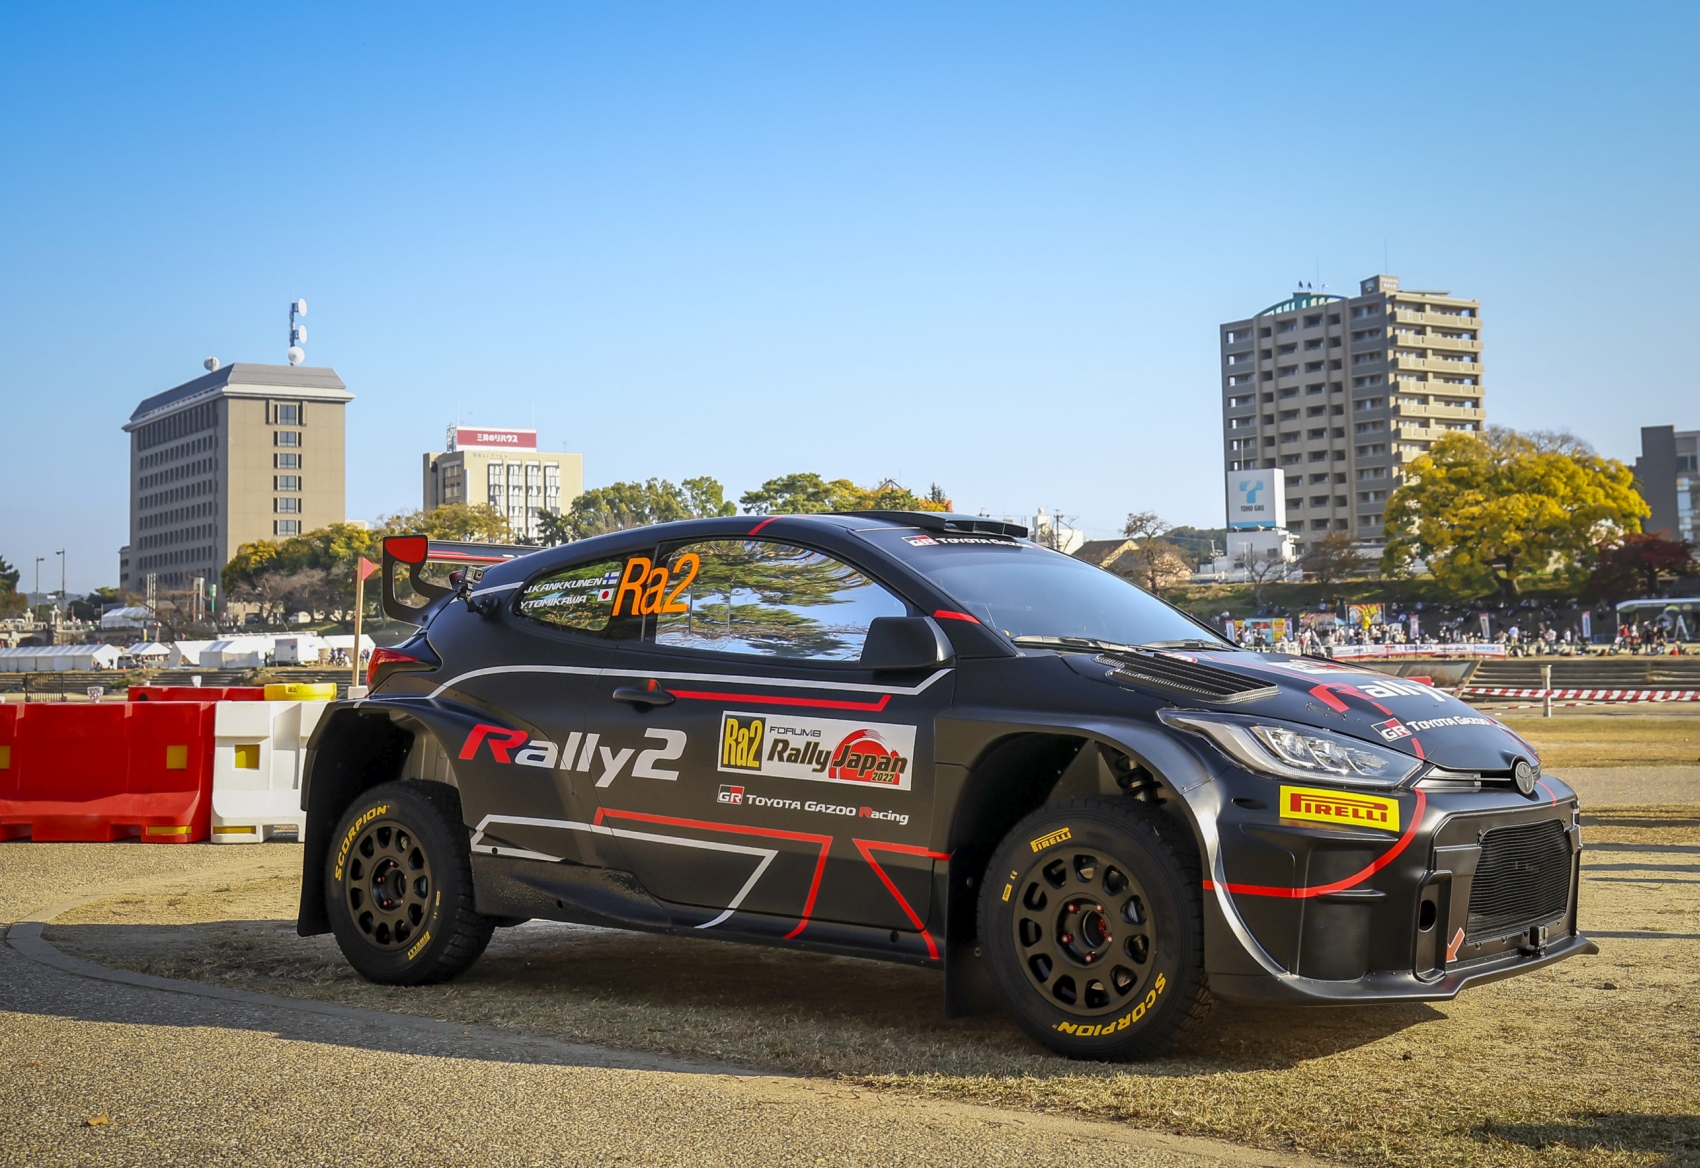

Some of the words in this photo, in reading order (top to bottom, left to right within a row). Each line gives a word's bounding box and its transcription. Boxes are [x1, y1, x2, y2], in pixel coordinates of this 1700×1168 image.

[477, 433, 518, 443] 三井のリハウス
[524, 577, 603, 594] J.KANKKUNEN
[612, 553, 700, 617] Ra2
[520, 595, 588, 610] Y.TOMIKAWA
[723, 718, 763, 768] Ra2
[769, 726, 821, 738] FORUM8
[1381, 725, 1411, 739] GR
[1406, 719, 1457, 732] TOYOTA
[458, 723, 688, 788] Rally2
[766, 738, 833, 773] Rally
[833, 745, 908, 776] Japan
[871, 772, 895, 783] 2022
[719, 791, 743, 804] GR
[746, 794, 801, 810] TOYOTA
[804, 801, 856, 816] GAZOO
[858, 807, 909, 825] Racing
[1290, 793, 1388, 822] PIRELLI
[335, 804, 387, 881] SCORPION
[1030, 827, 1072, 853] PIRELLI
[1057, 972, 1166, 1036] SCORPION
